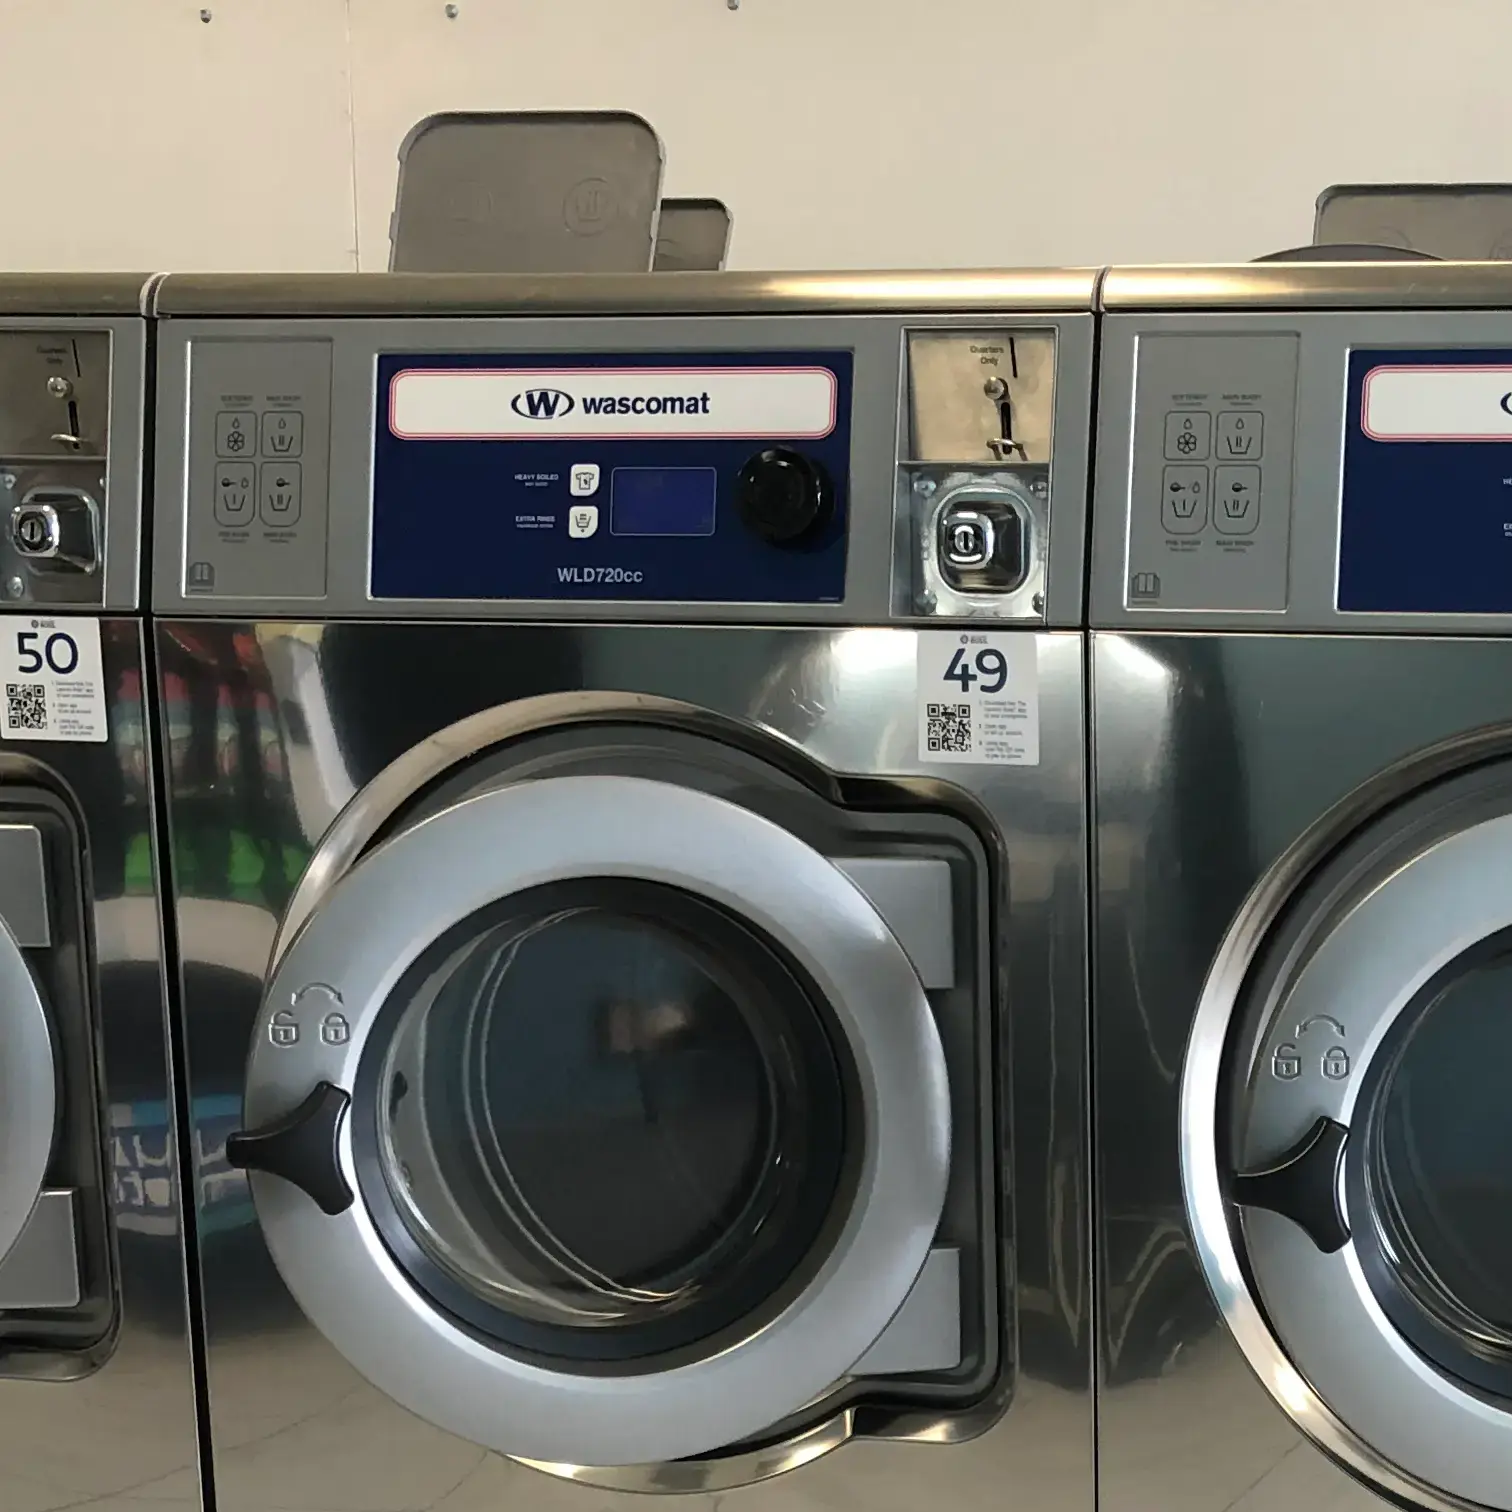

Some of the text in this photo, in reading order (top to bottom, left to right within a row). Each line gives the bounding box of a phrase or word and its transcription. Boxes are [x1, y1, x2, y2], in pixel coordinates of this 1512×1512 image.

[970, 346, 1004, 354] Quarters
[980, 357, 999, 366] Only
[582, 392, 710, 414] wascomat
[557, 568, 643, 582] WLD720cc
[17, 632, 78, 674] 50
[943, 648, 1008, 693] 49
